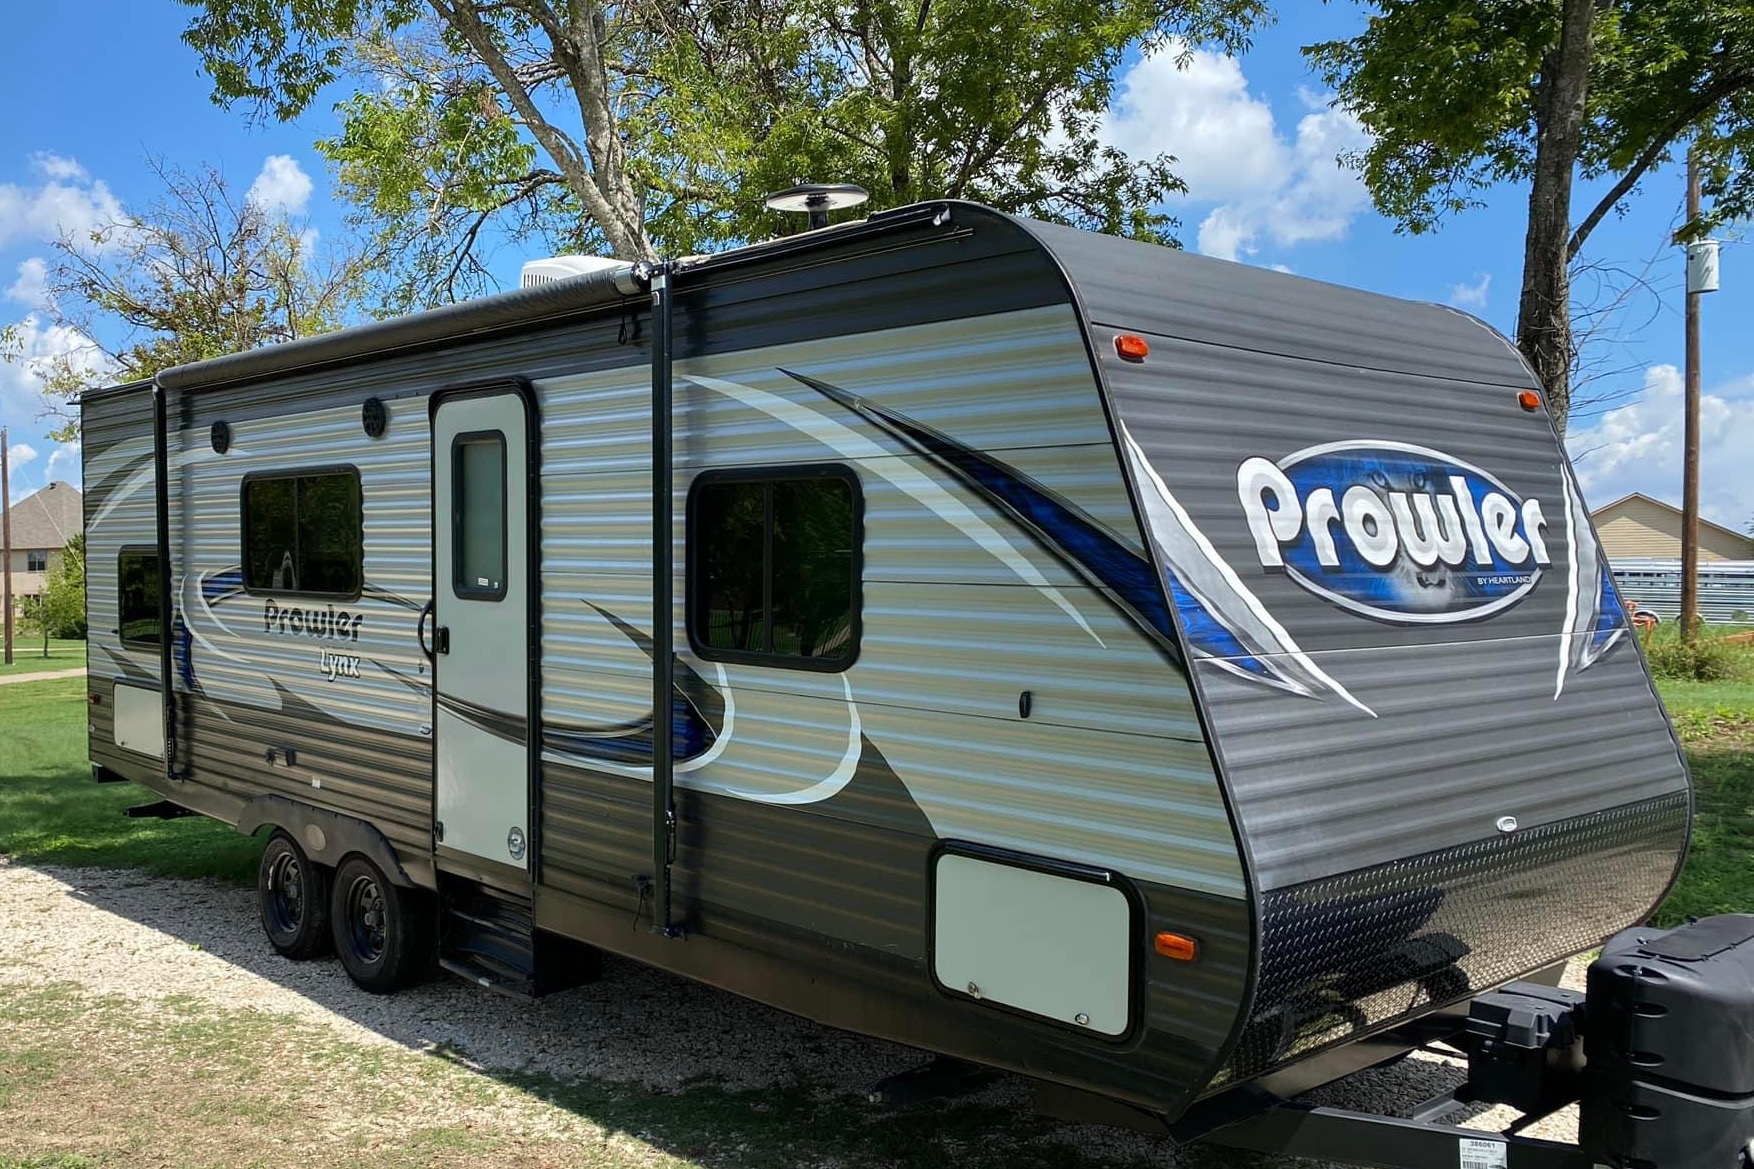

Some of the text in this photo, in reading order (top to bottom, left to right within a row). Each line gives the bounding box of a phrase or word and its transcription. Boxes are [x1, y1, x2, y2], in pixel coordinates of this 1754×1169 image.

[1236, 456, 1551, 568] Prowler
[1477, 575, 1531, 585] BY HEARTLAND
[264, 599, 363, 642] Prowler
[320, 648, 361, 682] Lynx
